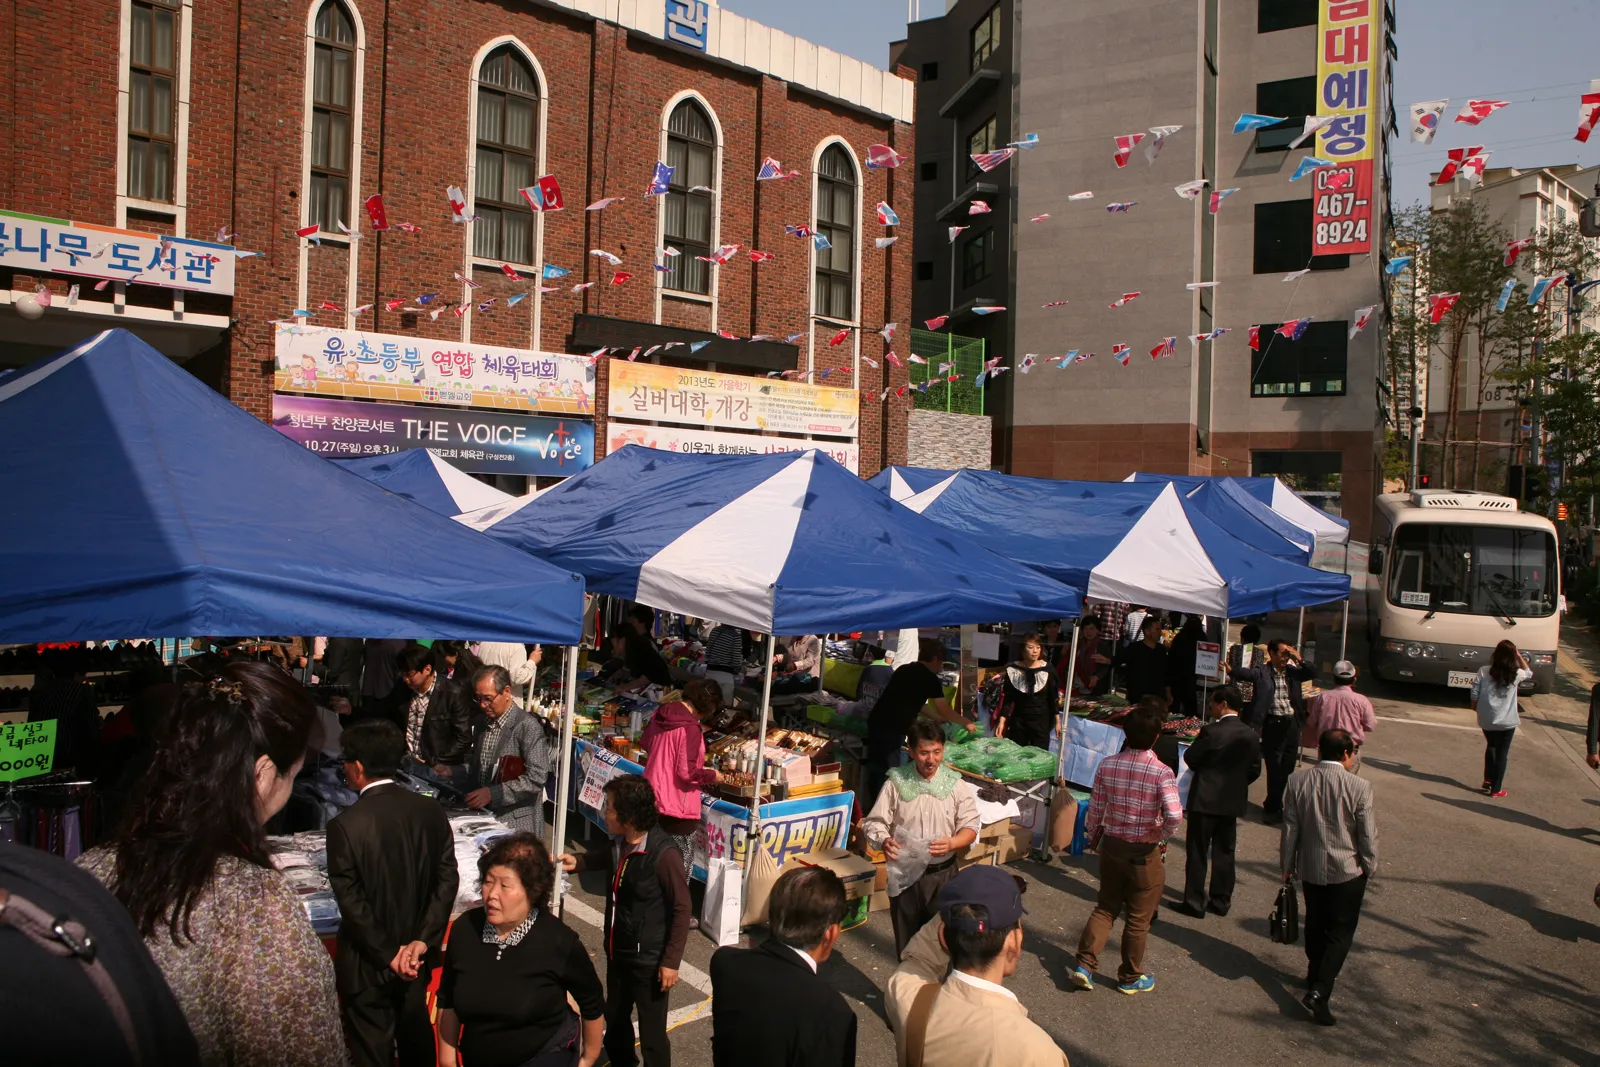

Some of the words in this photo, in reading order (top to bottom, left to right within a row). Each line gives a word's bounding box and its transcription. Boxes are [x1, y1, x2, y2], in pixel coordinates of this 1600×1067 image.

[668, 0, 707, 48] 관
[1317, 192, 1368, 217] 467-
[1316, 219, 1367, 246] 8924
[108, 242, 215, 285] 도서관
[431, 349, 475, 378] 연합
[482, 353, 559, 383] 체육대회
[678, 375, 716, 389] 2013년도
[718, 378, 751, 393] 가을학기
[629, 385, 710, 418] 실버대학
[715, 395, 753, 422] 개강
[289, 413, 328, 430] 청년부
[331, 416, 396, 434] 찬양콘서트
[401, 418, 449, 442] THE
[457, 422, 527, 445] VOICE
[460, 449, 485, 460] 체육관
[23, 723, 43, 737] 실크
[596, 748, 620, 764] 화장품
